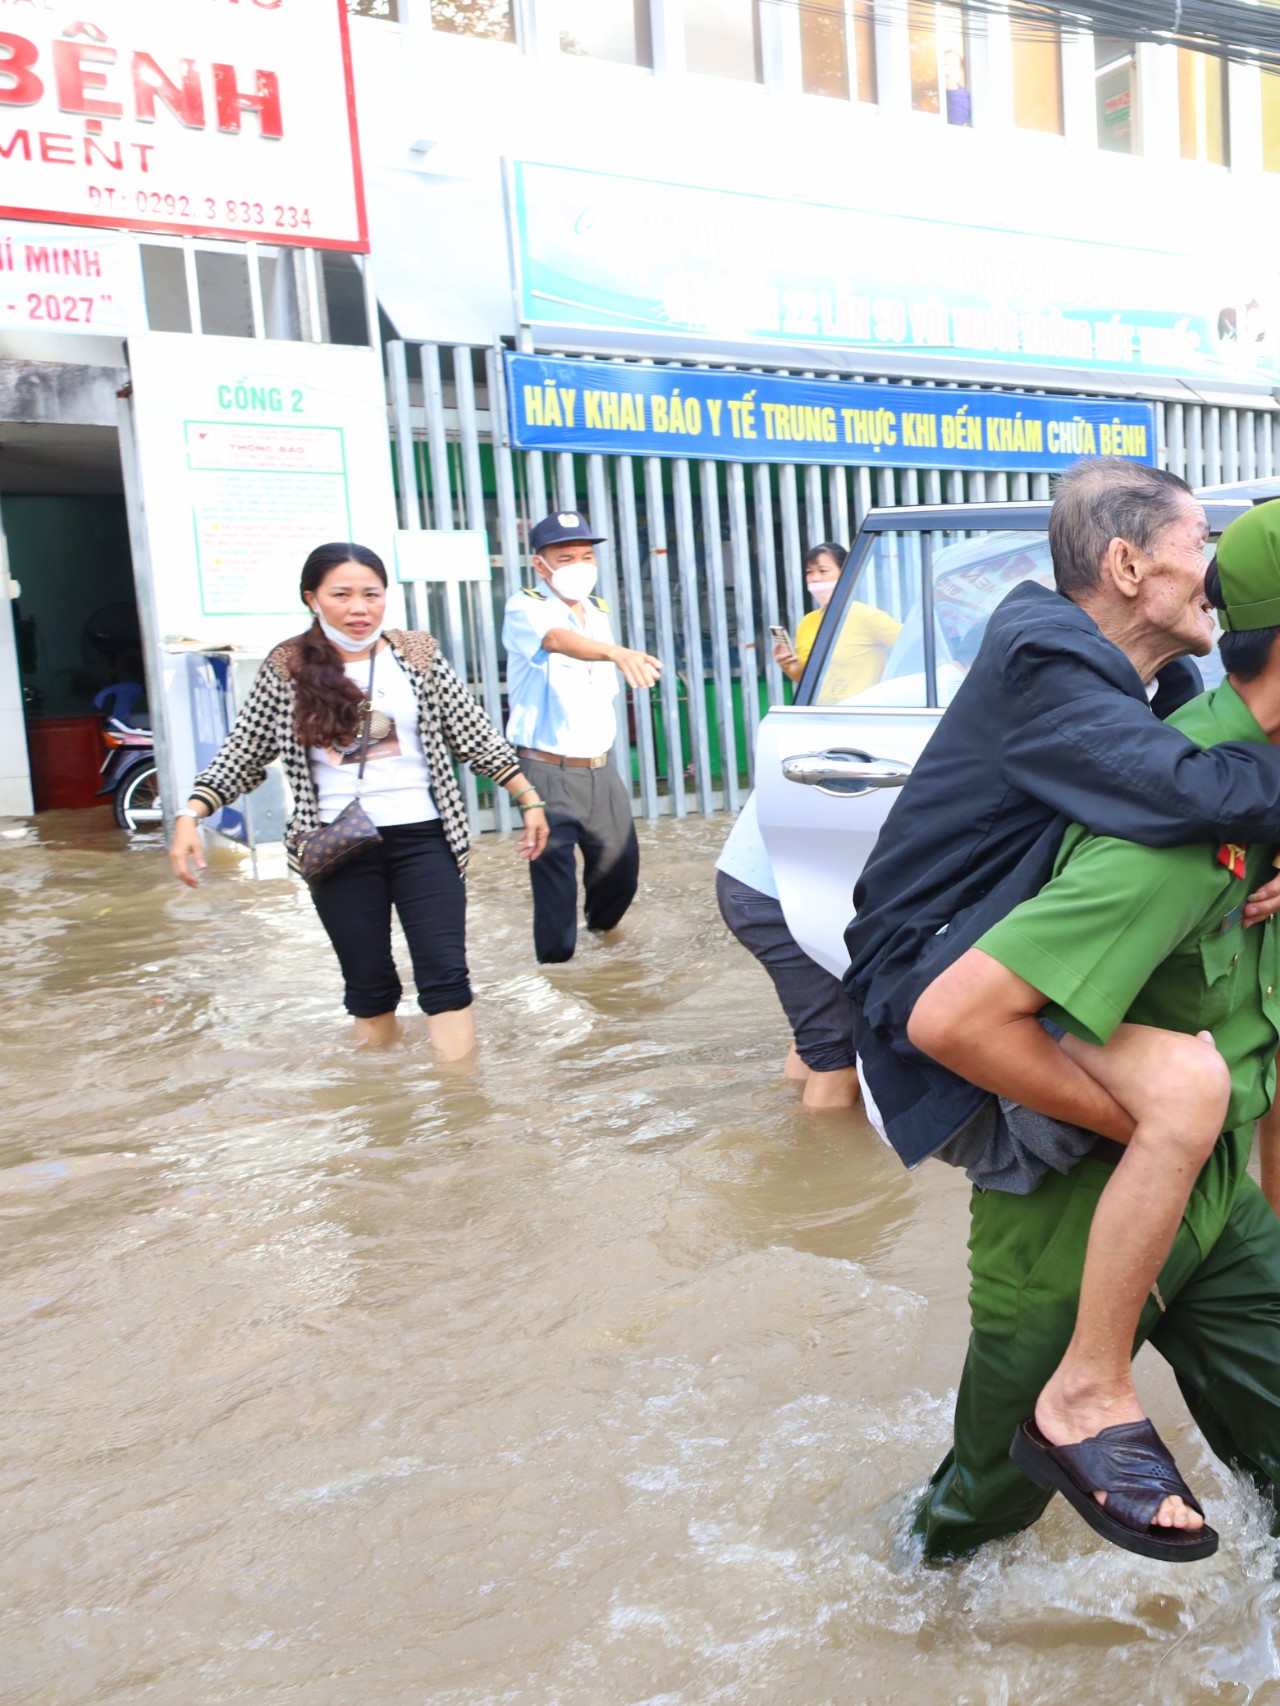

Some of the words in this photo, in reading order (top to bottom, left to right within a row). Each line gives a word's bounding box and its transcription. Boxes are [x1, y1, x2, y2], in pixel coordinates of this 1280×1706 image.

[205, 197, 216, 219] 3
[226, 200, 264, 225] 833
[274, 205, 312, 229] 234
[24, 245, 102, 277] MINH
[291, 389, 304, 413] 2
[523, 379, 576, 427] HÃY
[583, 390, 646, 432] KHAI
[652, 388, 701, 435] BÁO
[707, 399, 722, 437] Y
[728, 389, 757, 440] TẾ
[761, 402, 838, 443] TRUNG
[841, 407, 897, 453] THỰC
[902, 412, 938, 448] KHI
[941, 404, 983, 451] ĐẾN
[986, 411, 1043, 453] KHÁM
[1047, 416, 1097, 455] CHỮA
